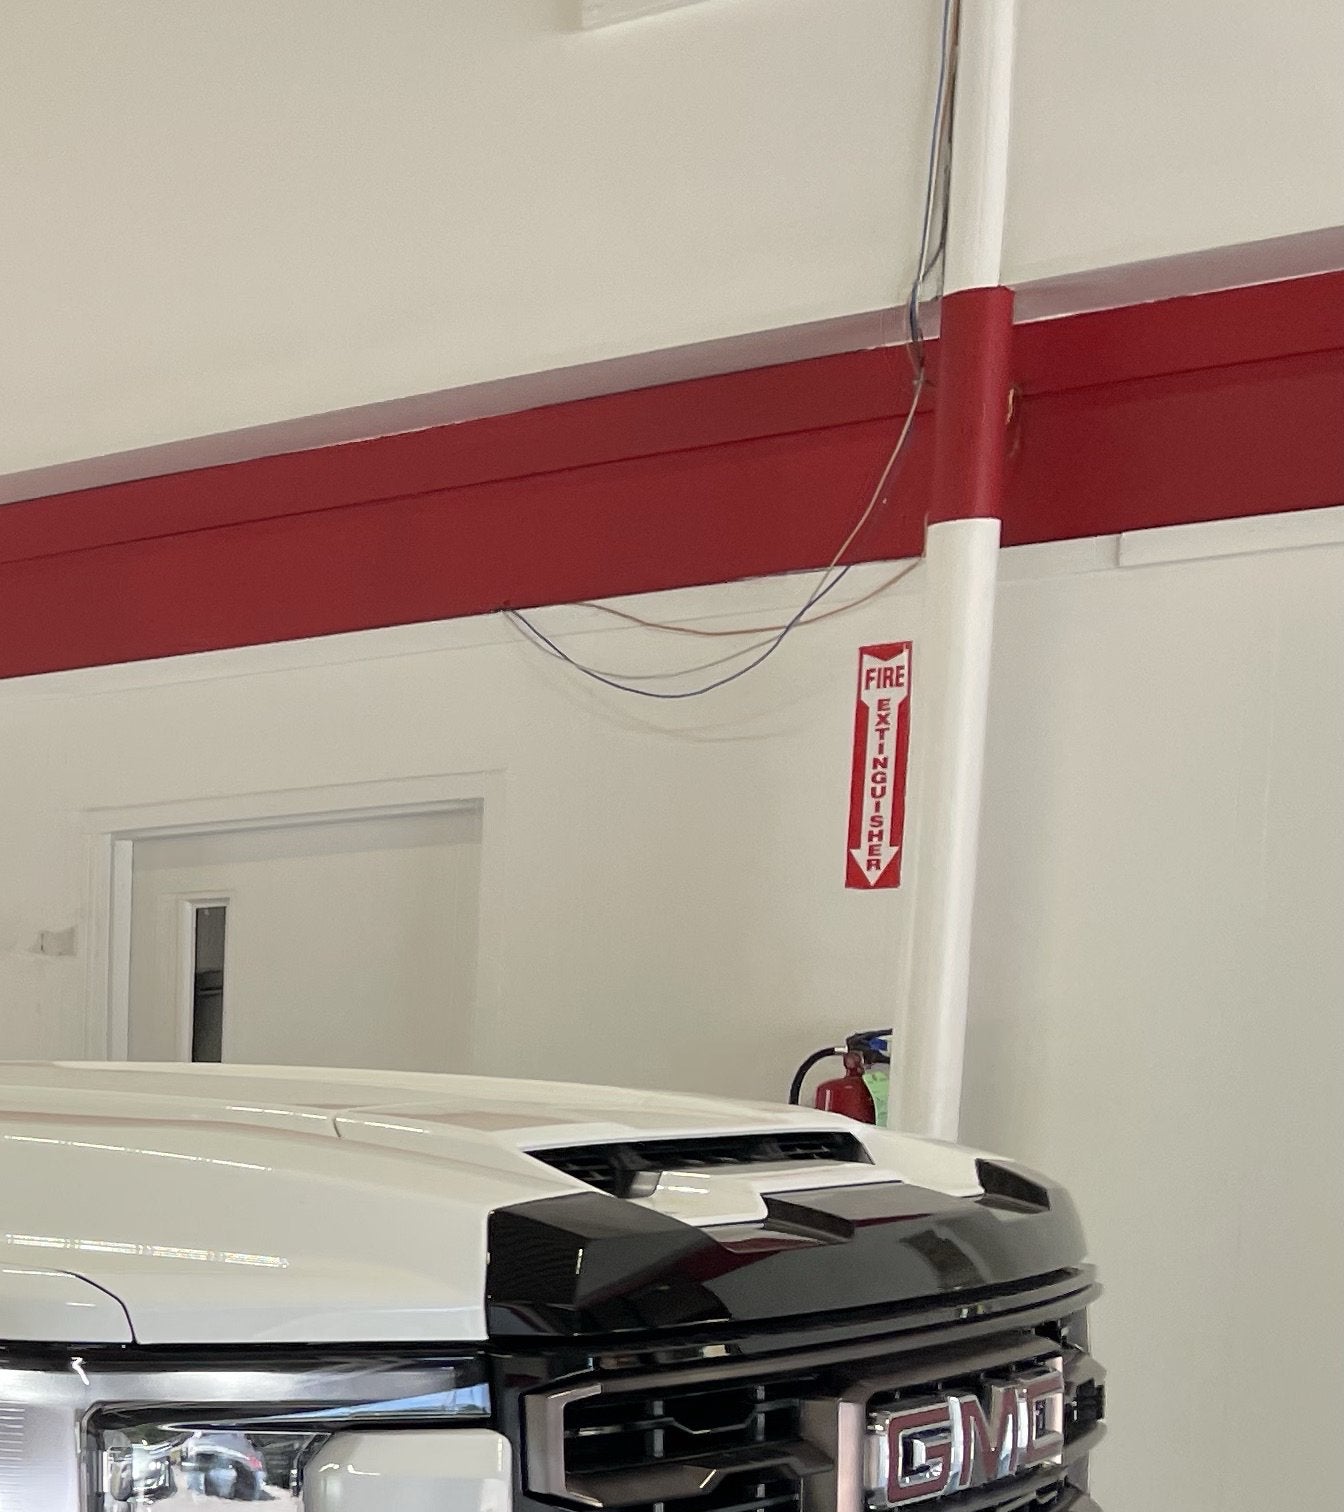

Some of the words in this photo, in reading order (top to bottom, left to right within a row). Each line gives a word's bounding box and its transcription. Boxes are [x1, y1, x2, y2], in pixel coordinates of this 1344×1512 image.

[864, 665, 905, 690] FIRE
[866, 698, 891, 872] EXTINGUISHER
[867, 1367, 1064, 1507] GMC
